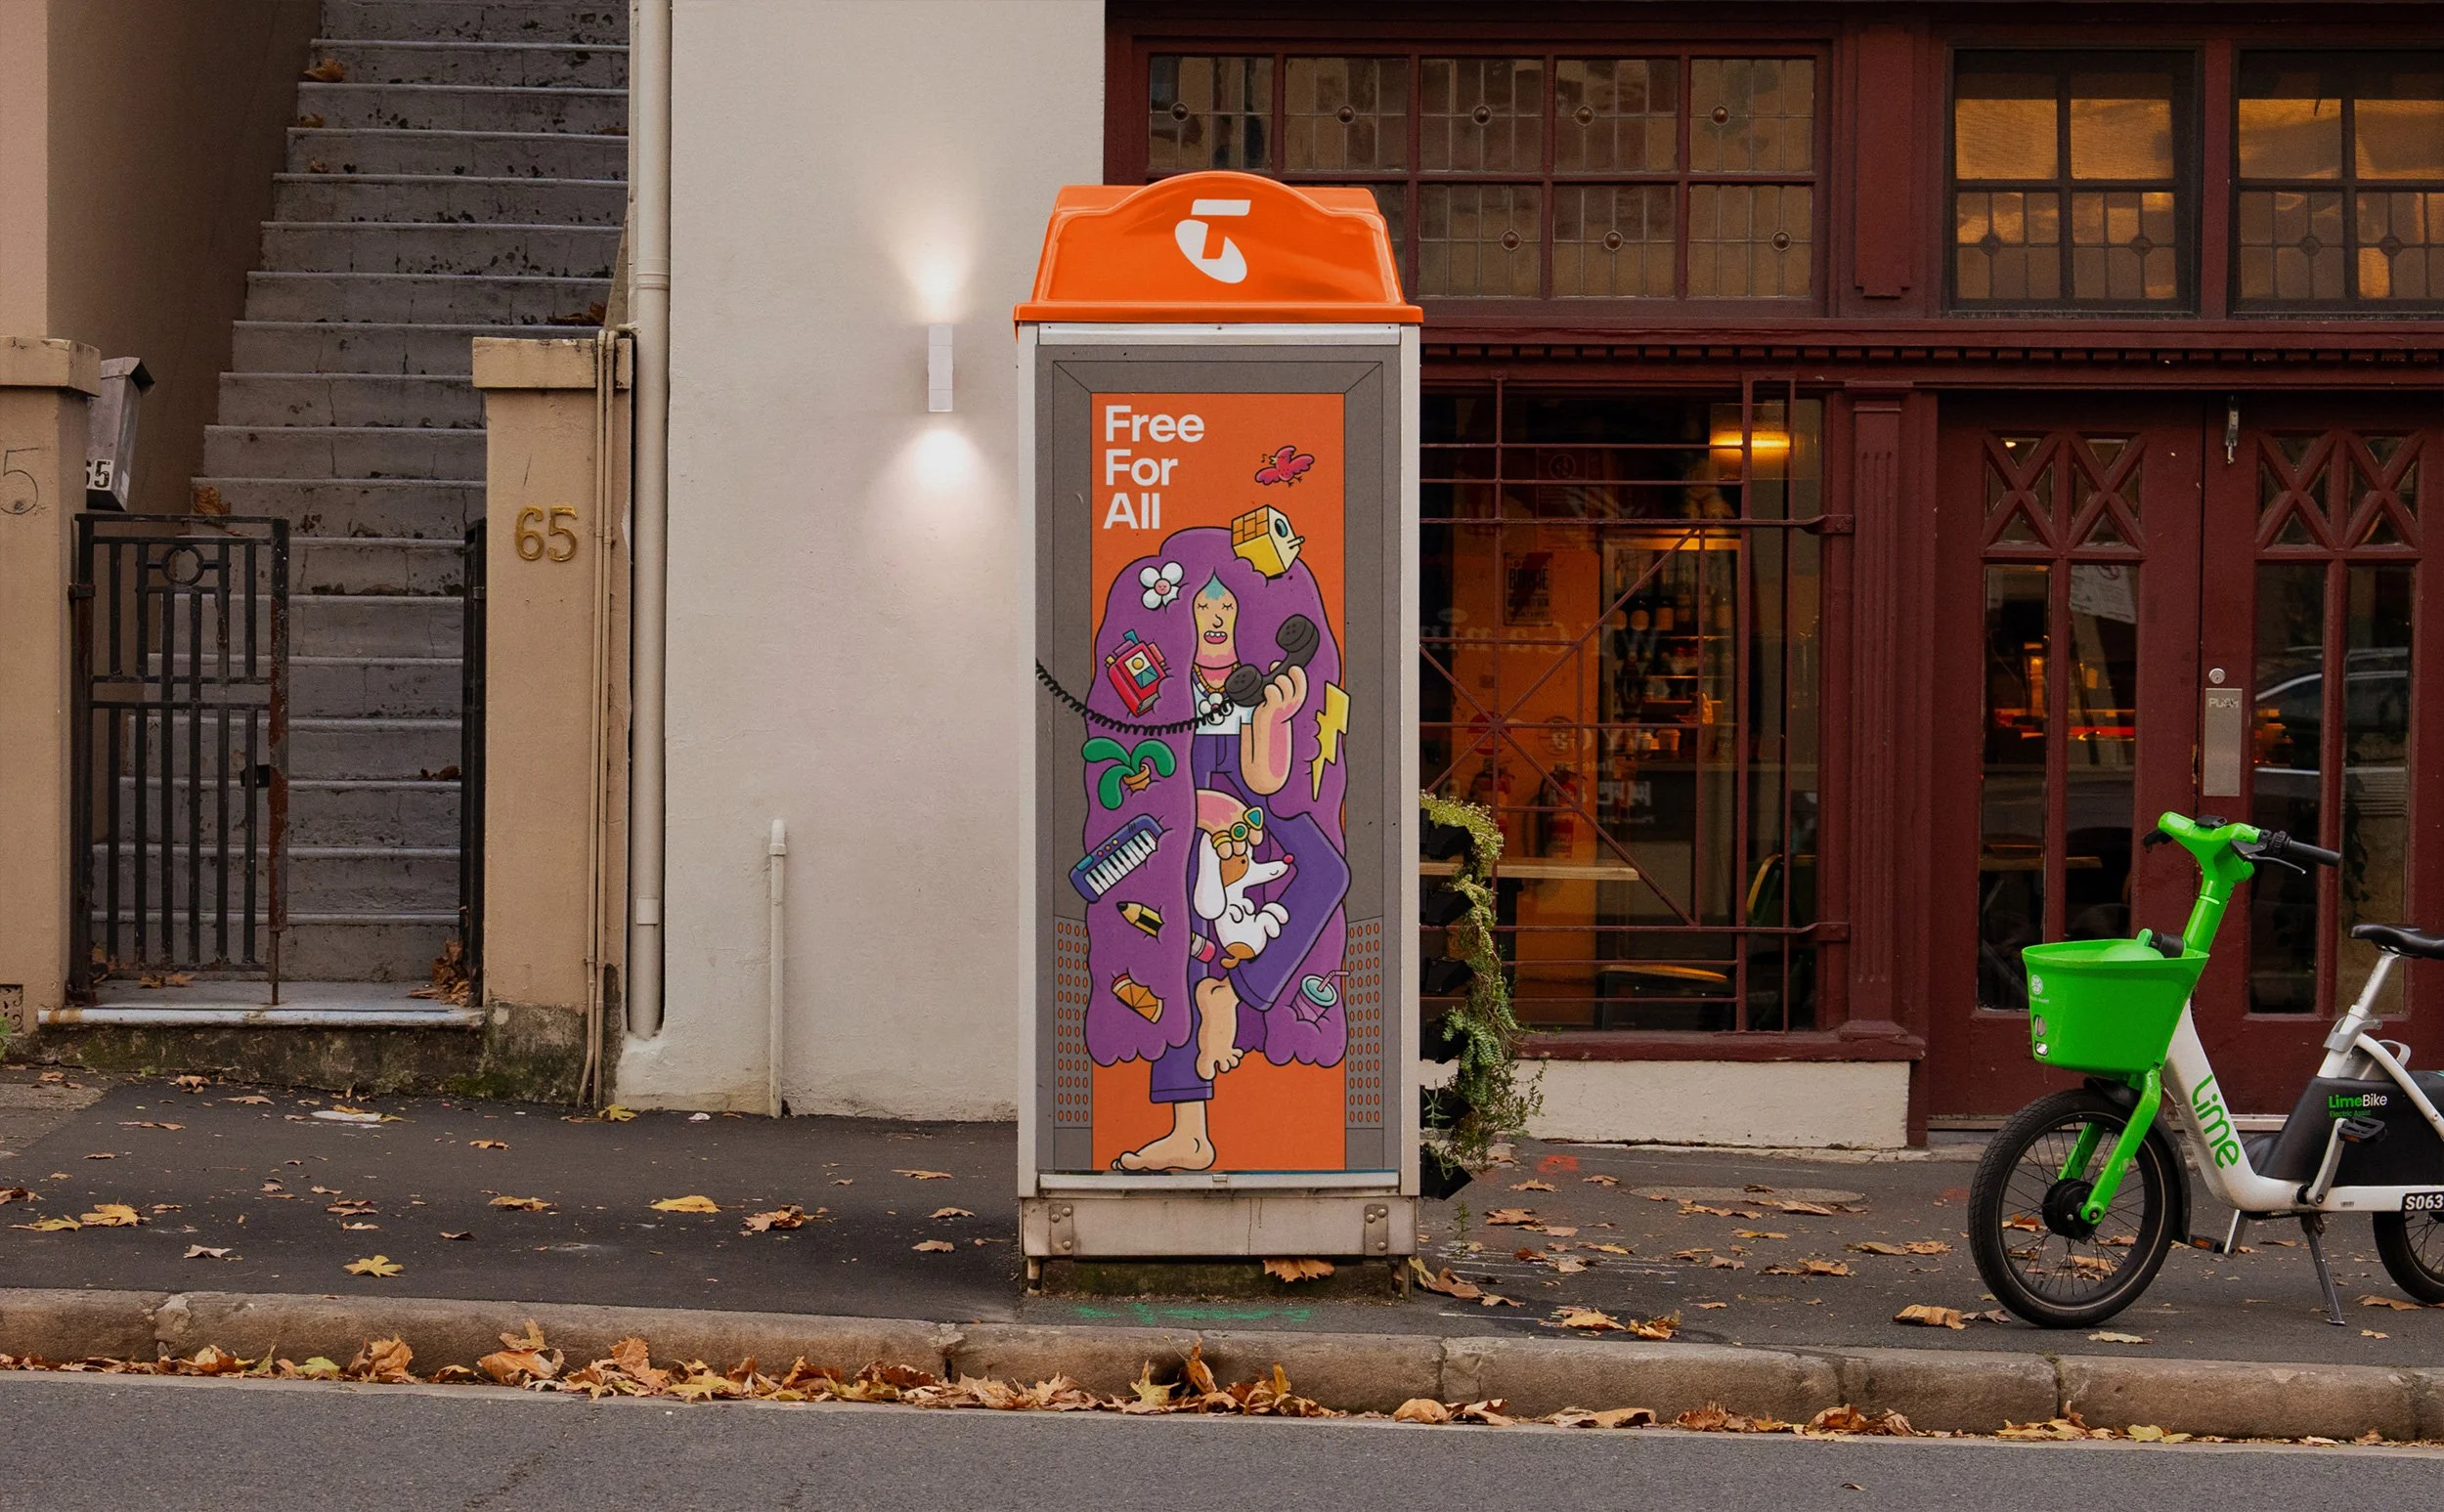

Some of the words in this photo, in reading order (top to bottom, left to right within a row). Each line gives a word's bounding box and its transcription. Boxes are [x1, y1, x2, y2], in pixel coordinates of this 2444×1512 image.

[1105, 405, 1205, 443] Free
[1105, 449, 1178, 486] For
[1103, 492, 1160, 530] All
[515, 504, 578, 562] 65
[2208, 698, 2240, 709] PUSH
[2329, 1093, 2388, 1108] LimeBike
[2191, 1073, 2240, 1170] Lime
[2405, 1193, 2444, 1211] S063
